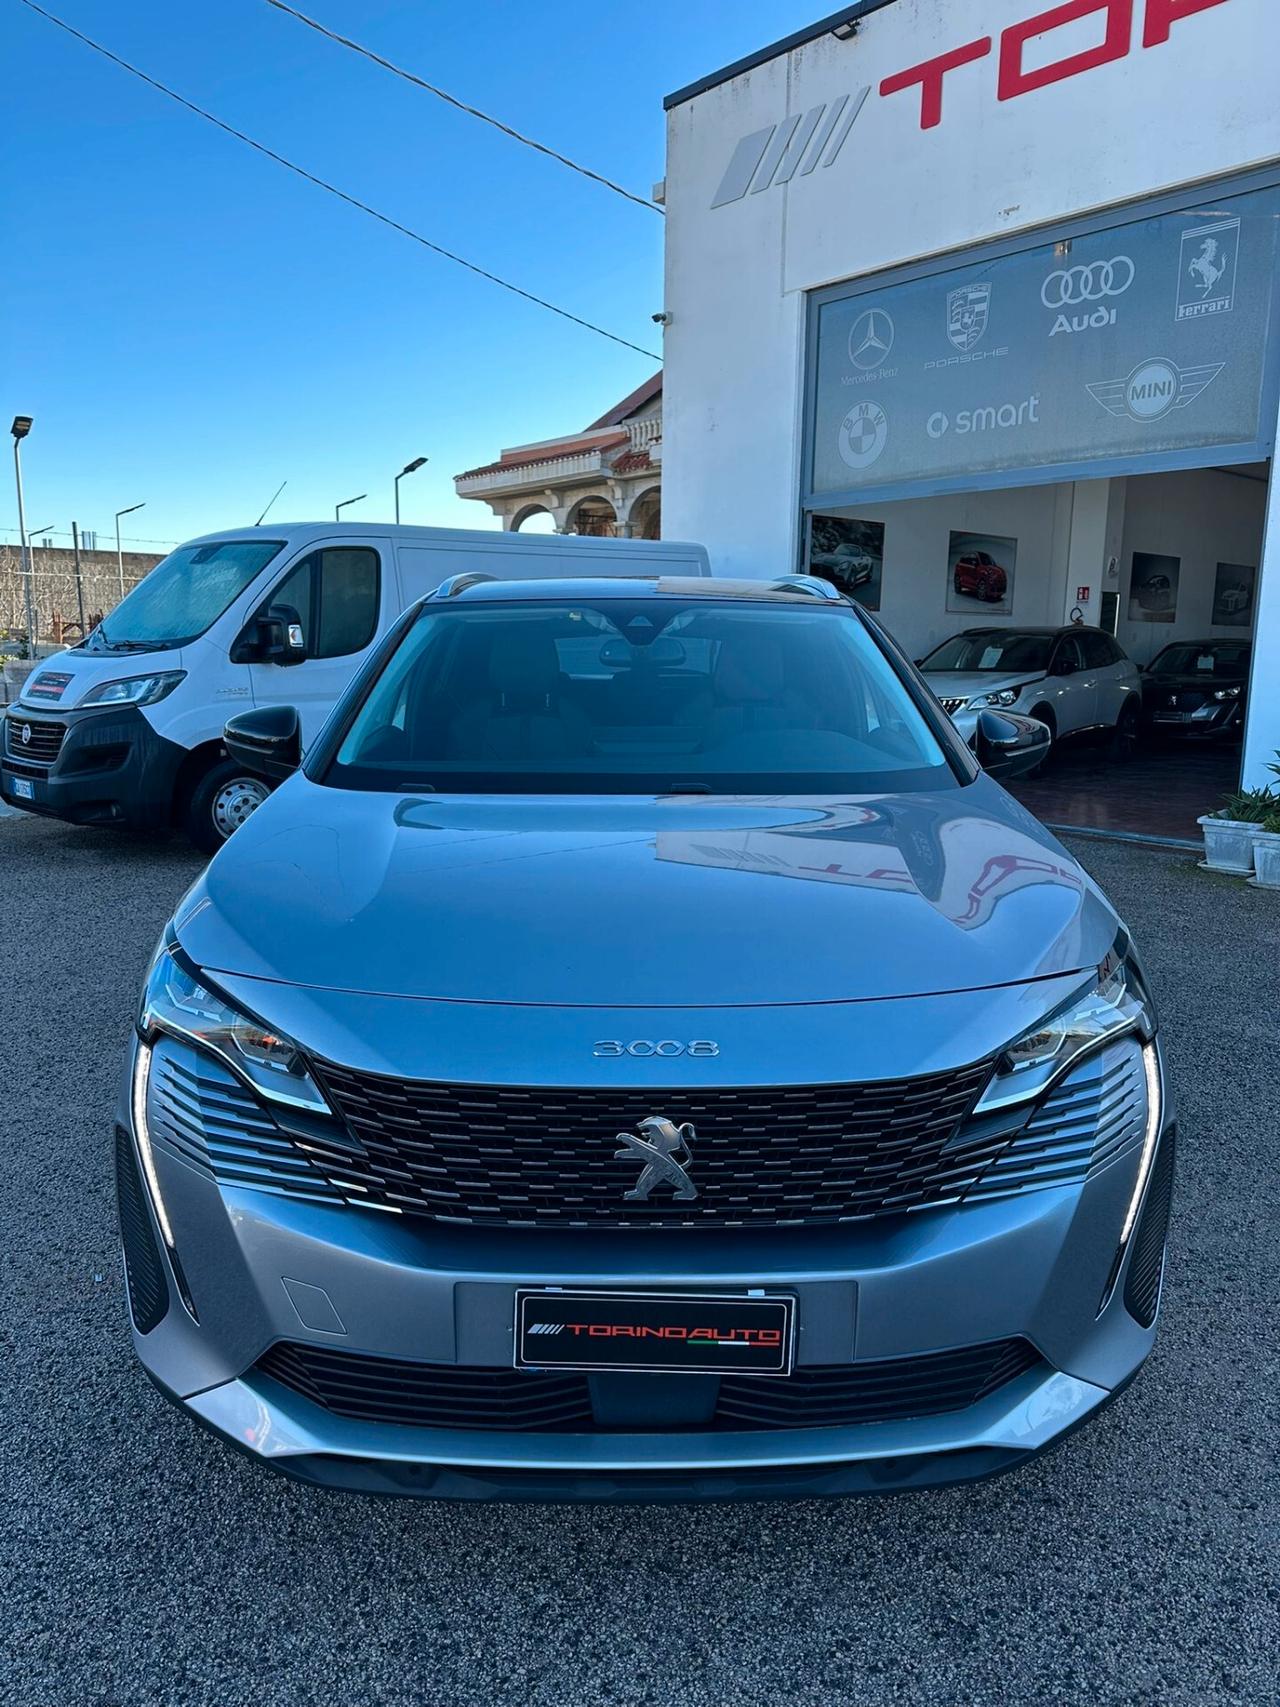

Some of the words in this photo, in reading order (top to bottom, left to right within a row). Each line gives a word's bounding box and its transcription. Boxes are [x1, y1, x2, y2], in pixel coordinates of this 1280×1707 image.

[1178, 298, 1232, 319] Ferrari
[1049, 306, 1117, 336] Audi
[924, 346, 1009, 369] PORSCHE
[1131, 380, 1172, 401] MINI
[842, 404, 885, 431] BMW
[955, 395, 1039, 434] smart
[593, 1040, 720, 1057] 3008
[567, 1324, 780, 1341] TORINOAUTO
